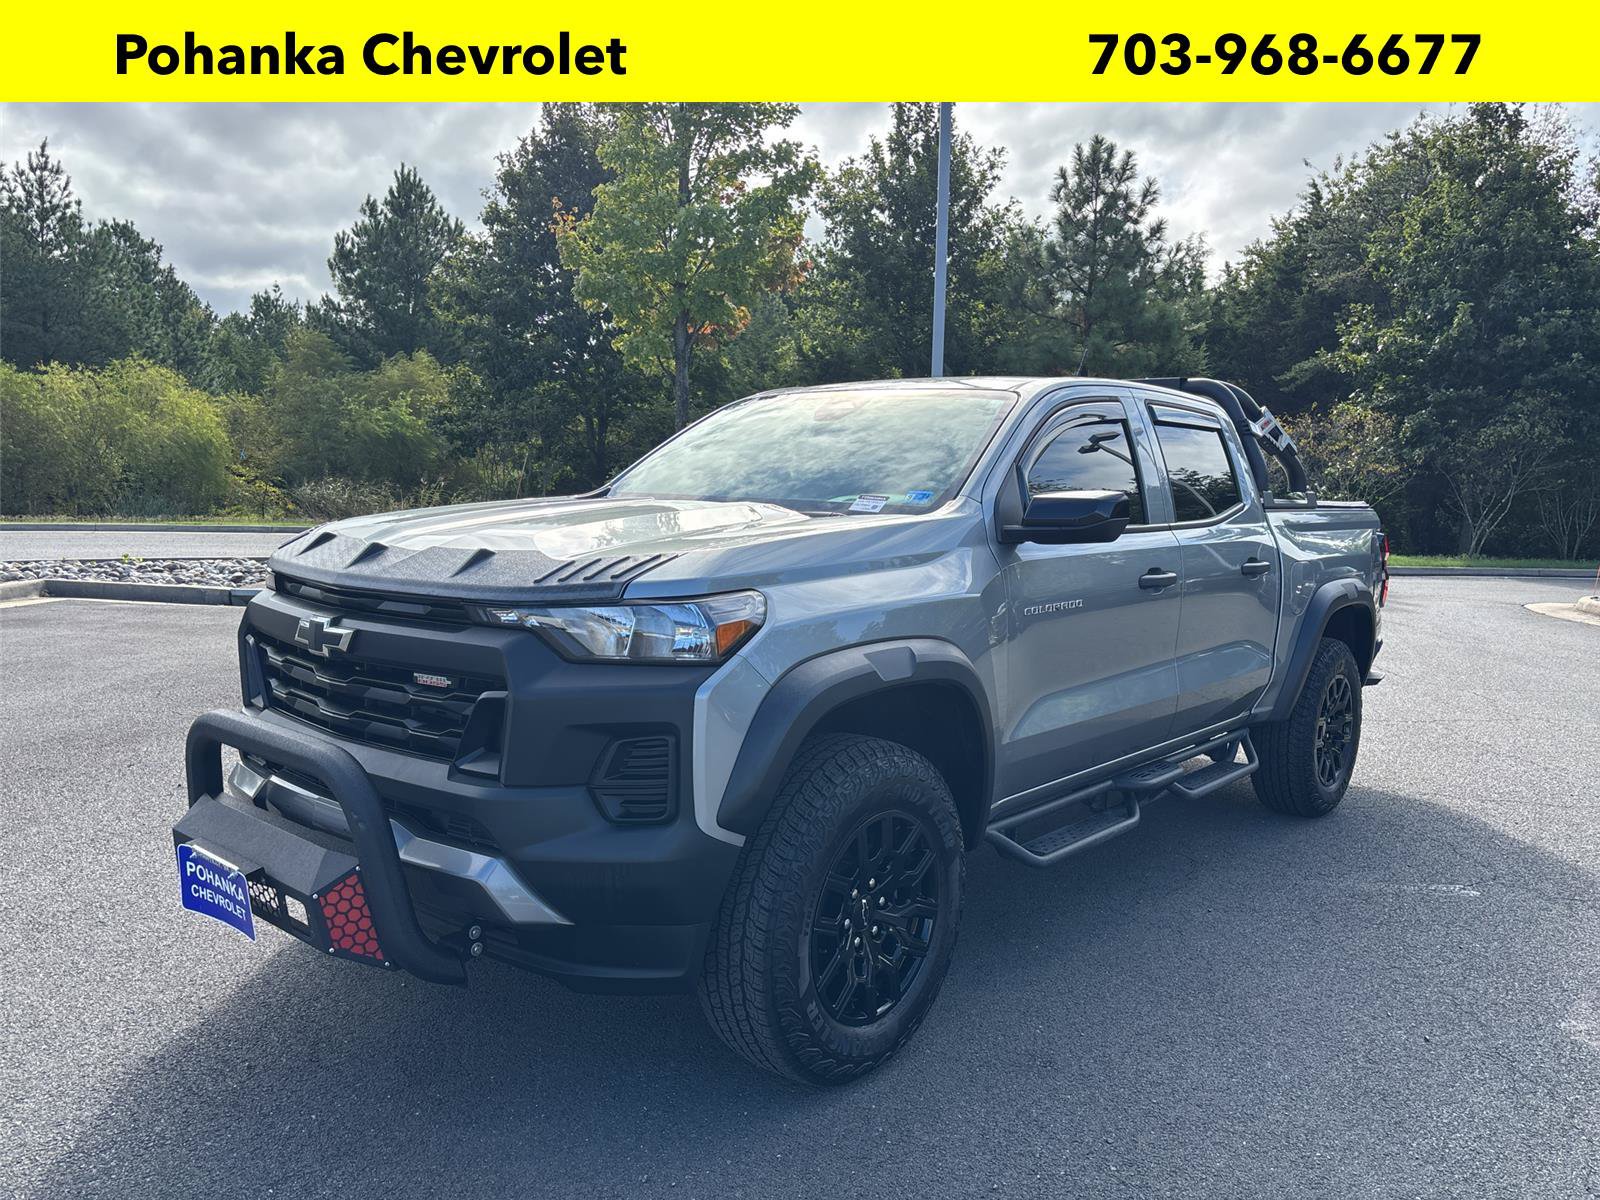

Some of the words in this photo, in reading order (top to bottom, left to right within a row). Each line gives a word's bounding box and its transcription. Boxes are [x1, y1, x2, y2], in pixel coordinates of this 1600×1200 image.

[1024, 599, 1084, 615] COLORADO
[186, 861, 246, 905] POHANKA
[191, 884, 246, 921] CHEVROLET
